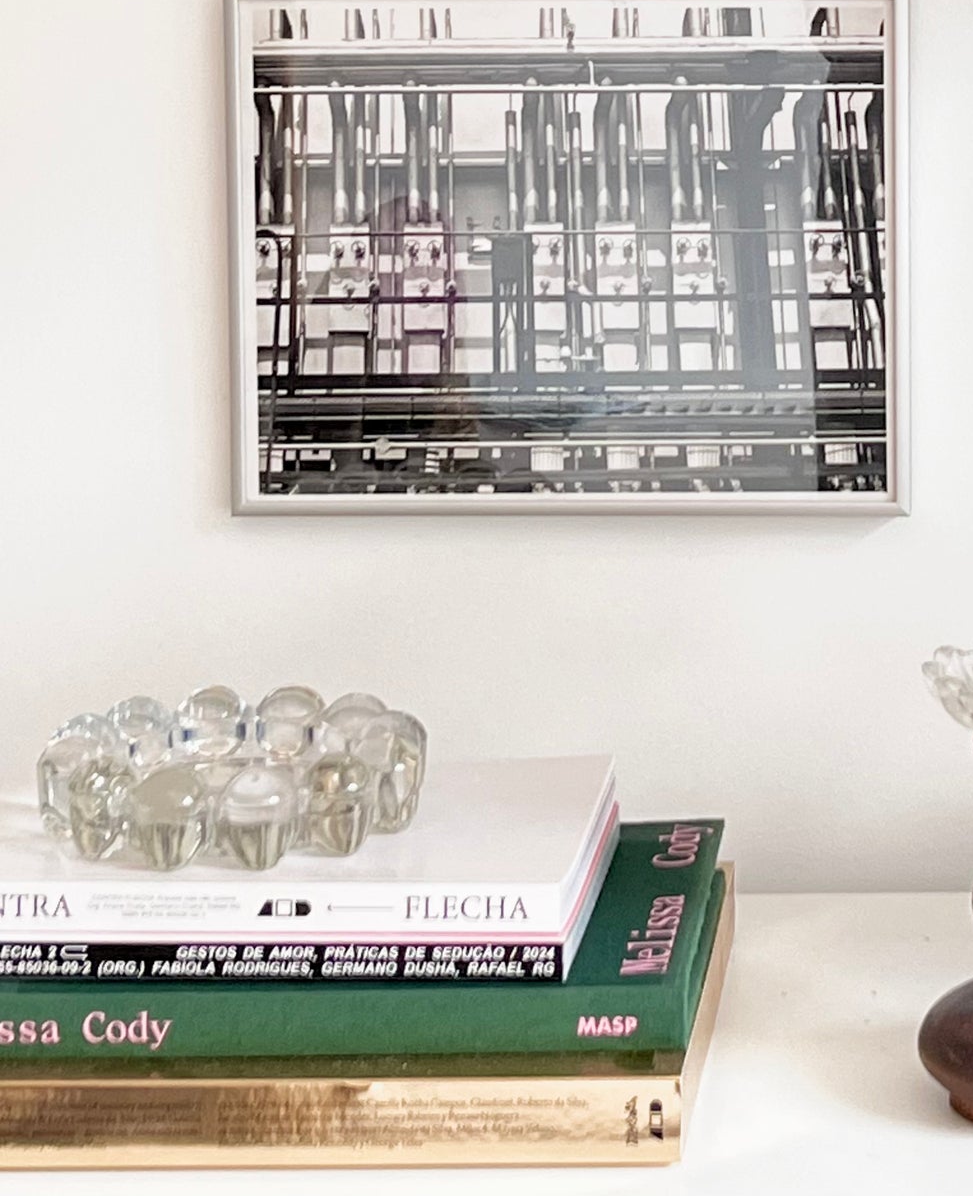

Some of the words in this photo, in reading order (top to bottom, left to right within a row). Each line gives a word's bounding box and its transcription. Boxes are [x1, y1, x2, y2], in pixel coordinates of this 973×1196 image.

[405, 894, 529, 920] FLECHA
[618, 894, 686, 975] Melissa
[652, 824, 714, 868] Cody
[175, 945, 238, 961] GESTOS
[242, 945, 264, 960] DE
[269, 945, 318, 963] AMOR,
[323, 943, 400, 961] PRÁTICAS
[404, 946, 427, 961] DE
[432, 942, 506, 962] SEDUÇÃO
[509, 946, 518, 961] /
[522, 946, 556, 962] 2024
[97, 960, 146, 978] (ORG.)
[221, 961, 315, 979] RODRIGUES,
[321, 961, 398, 977] GERMANO
[466, 961, 526, 977] RAFAEL
[532, 961, 556, 977] RG
[82, 1010, 174, 1051] Cody
[577, 1015, 639, 1037] MASP
